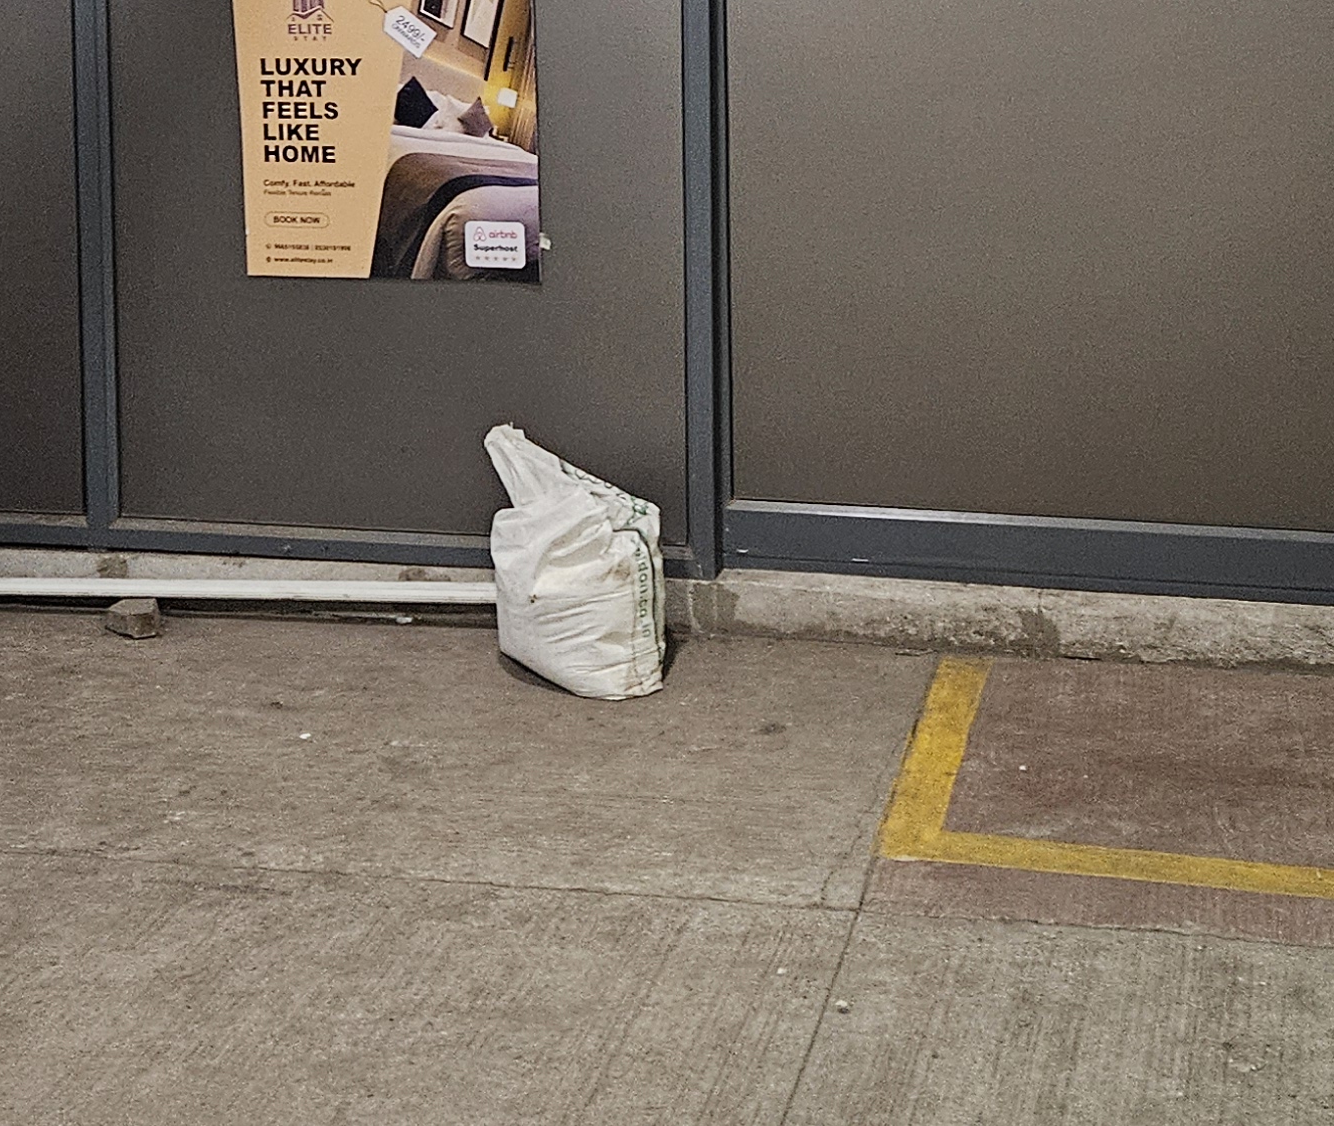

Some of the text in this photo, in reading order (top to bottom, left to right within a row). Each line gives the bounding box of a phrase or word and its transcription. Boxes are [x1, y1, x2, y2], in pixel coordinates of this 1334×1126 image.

[288, 24, 332, 34] ELITE
[396, 15, 425, 41] 2499/-
[260, 57, 363, 76] LUXURY
[260, 79, 327, 98] THAT
[262, 101, 339, 120] FEELS
[263, 124, 320, 142] LIKE
[264, 145, 336, 164] HOME
[489, 230, 518, 239] airbnb
[474, 244, 518, 252] Superhost
